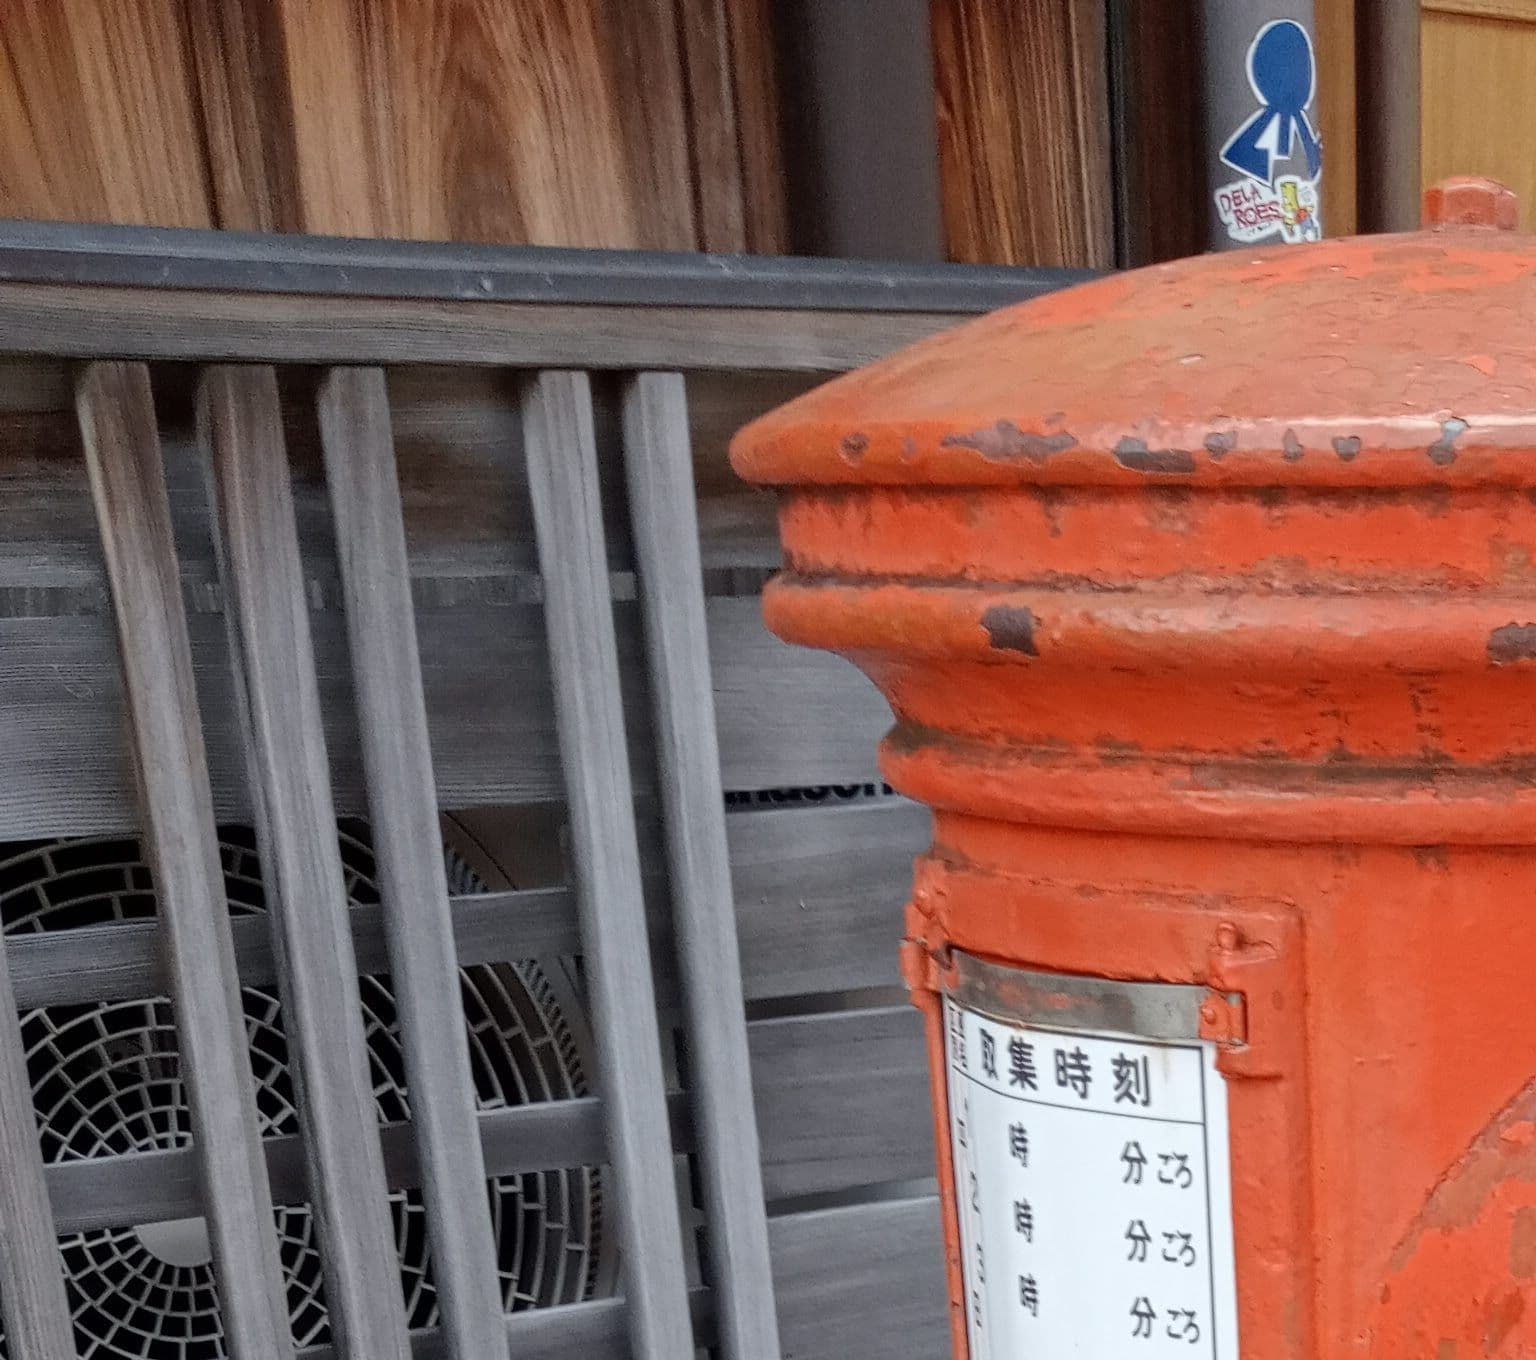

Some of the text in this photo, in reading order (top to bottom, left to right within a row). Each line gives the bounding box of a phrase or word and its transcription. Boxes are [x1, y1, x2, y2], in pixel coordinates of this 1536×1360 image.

[1008, 1121, 1029, 1168] 時
[1013, 1198, 1034, 1244] 時
[1018, 1273, 1039, 1318] 時
